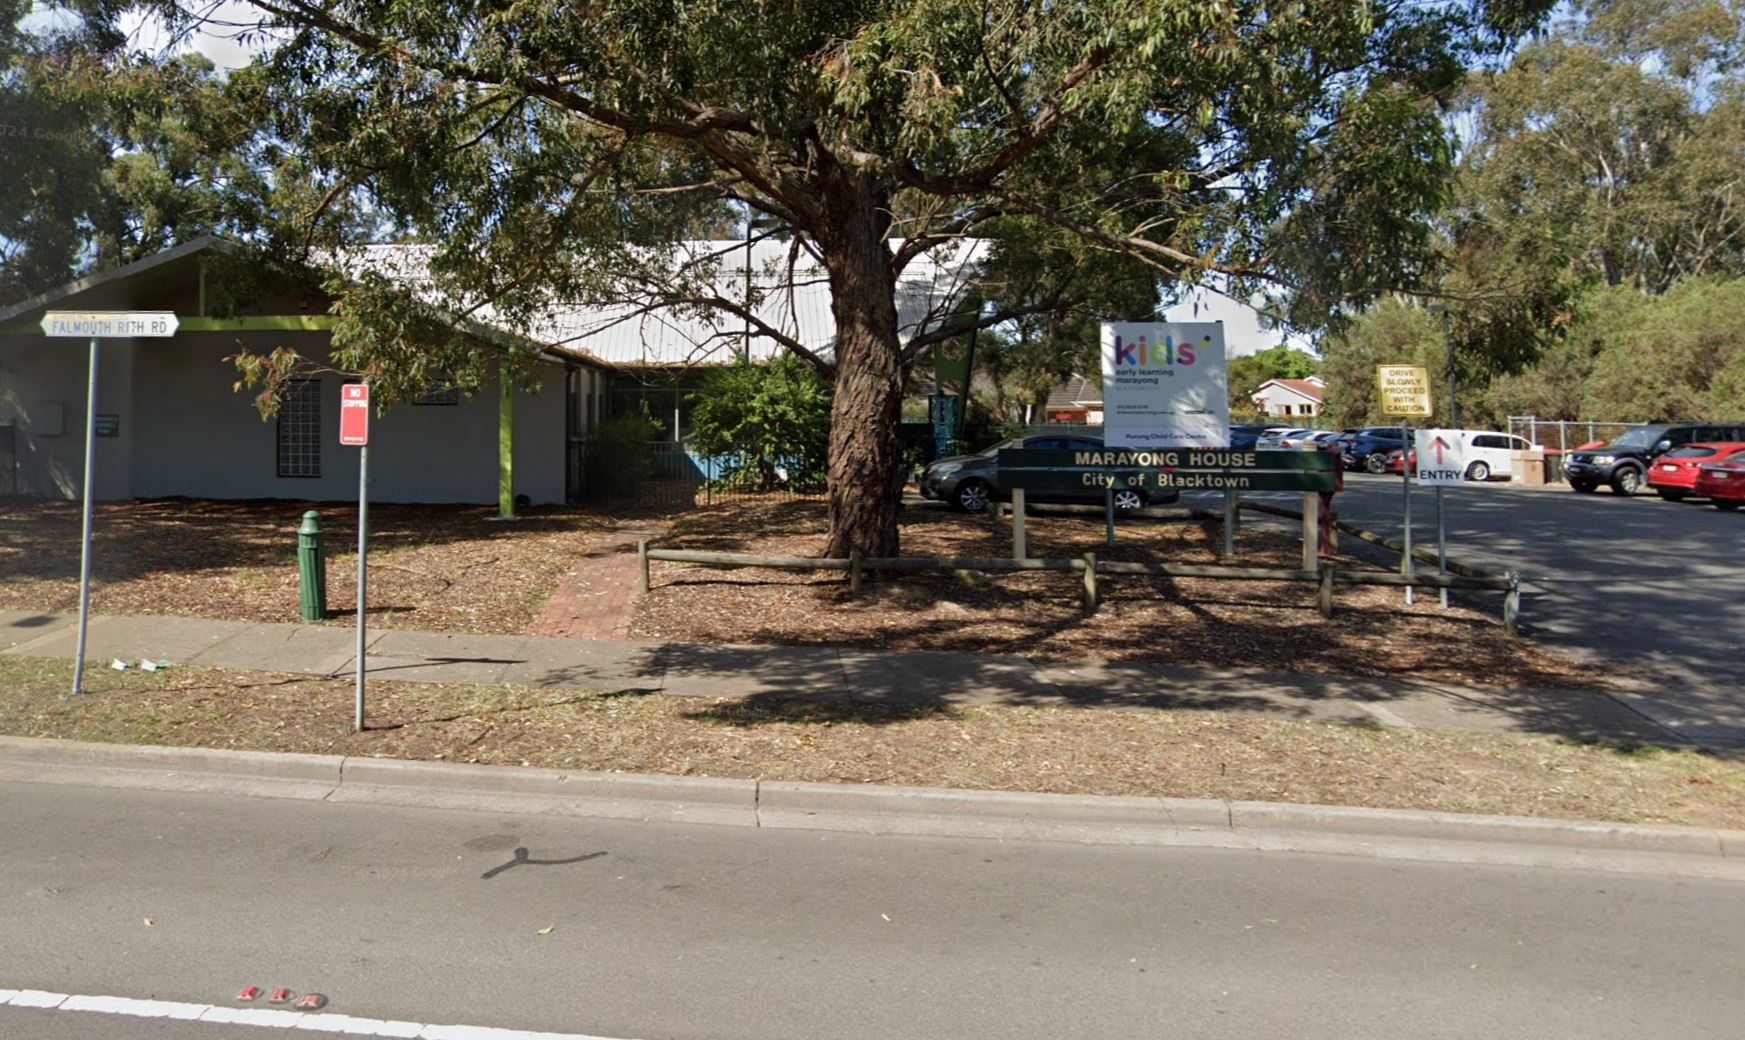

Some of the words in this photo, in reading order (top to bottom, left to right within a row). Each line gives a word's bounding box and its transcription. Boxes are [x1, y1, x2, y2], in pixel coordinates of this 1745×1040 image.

[52, 321, 111, 334] FALMOUTH
[151, 321, 167, 334] RD
[1116, 335, 1196, 366] kids
[1116, 368, 1137, 377] early
[1138, 368, 1175, 377] learning
[1389, 369, 1415, 377] DRIVE
[1116, 377, 1160, 386] marayong
[1386, 378, 1422, 386] SLOWLY
[1384, 387, 1425, 395] PROCEED
[1075, 452, 1179, 466] MARAYONG
[1189, 453, 1256, 467] HOUSE
[1419, 470, 1462, 480] ENTRY
[1082, 473, 1116, 489] City
[1128, 473, 1146, 487] of
[1158, 473, 1250, 488] Blacktown
